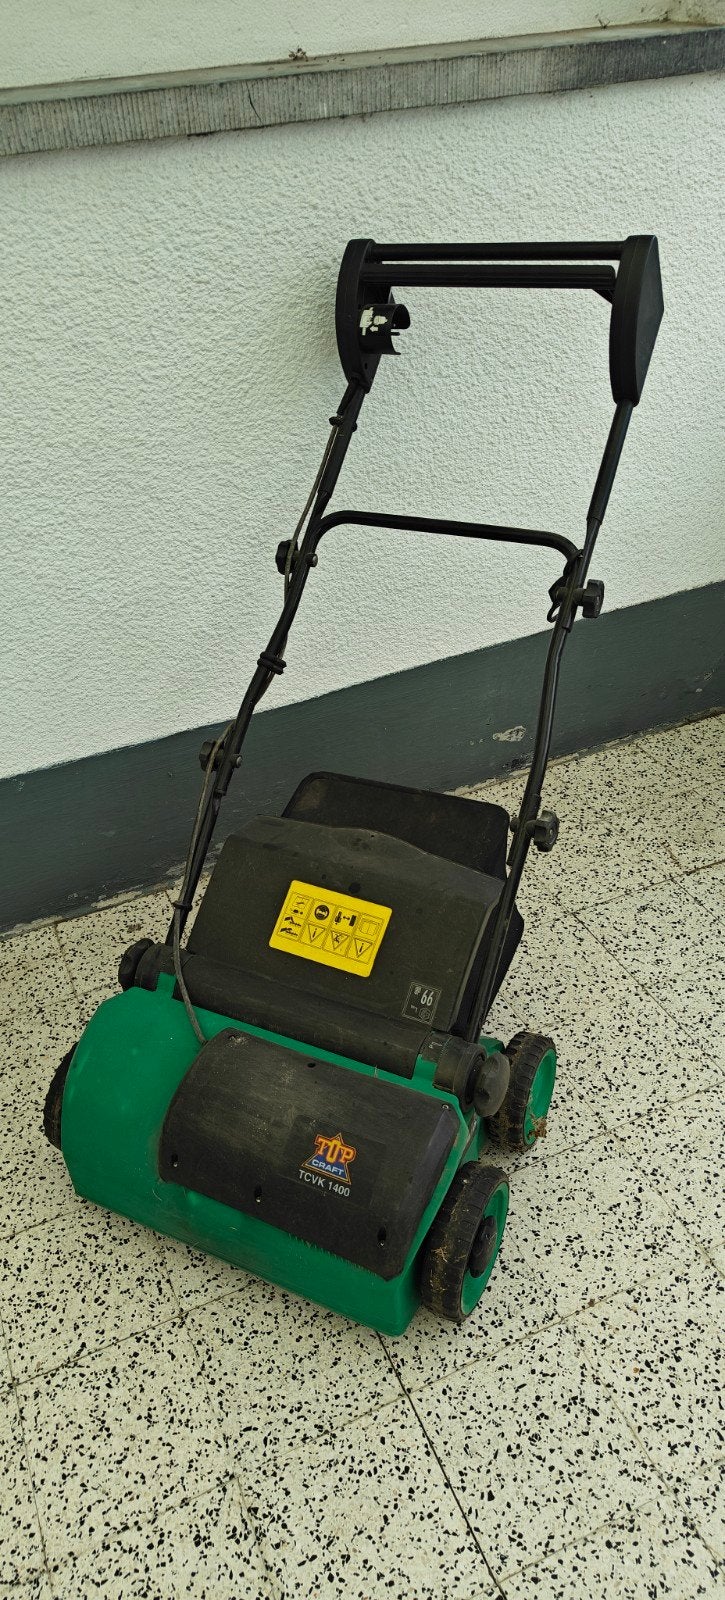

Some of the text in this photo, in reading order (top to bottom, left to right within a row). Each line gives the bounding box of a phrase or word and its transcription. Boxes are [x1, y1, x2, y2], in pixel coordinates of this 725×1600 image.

[315, 1136, 356, 1164] TOP
[311, 1159, 345, 1176] CRAFT
[299, 1169, 351, 1197] TCVK 1400
